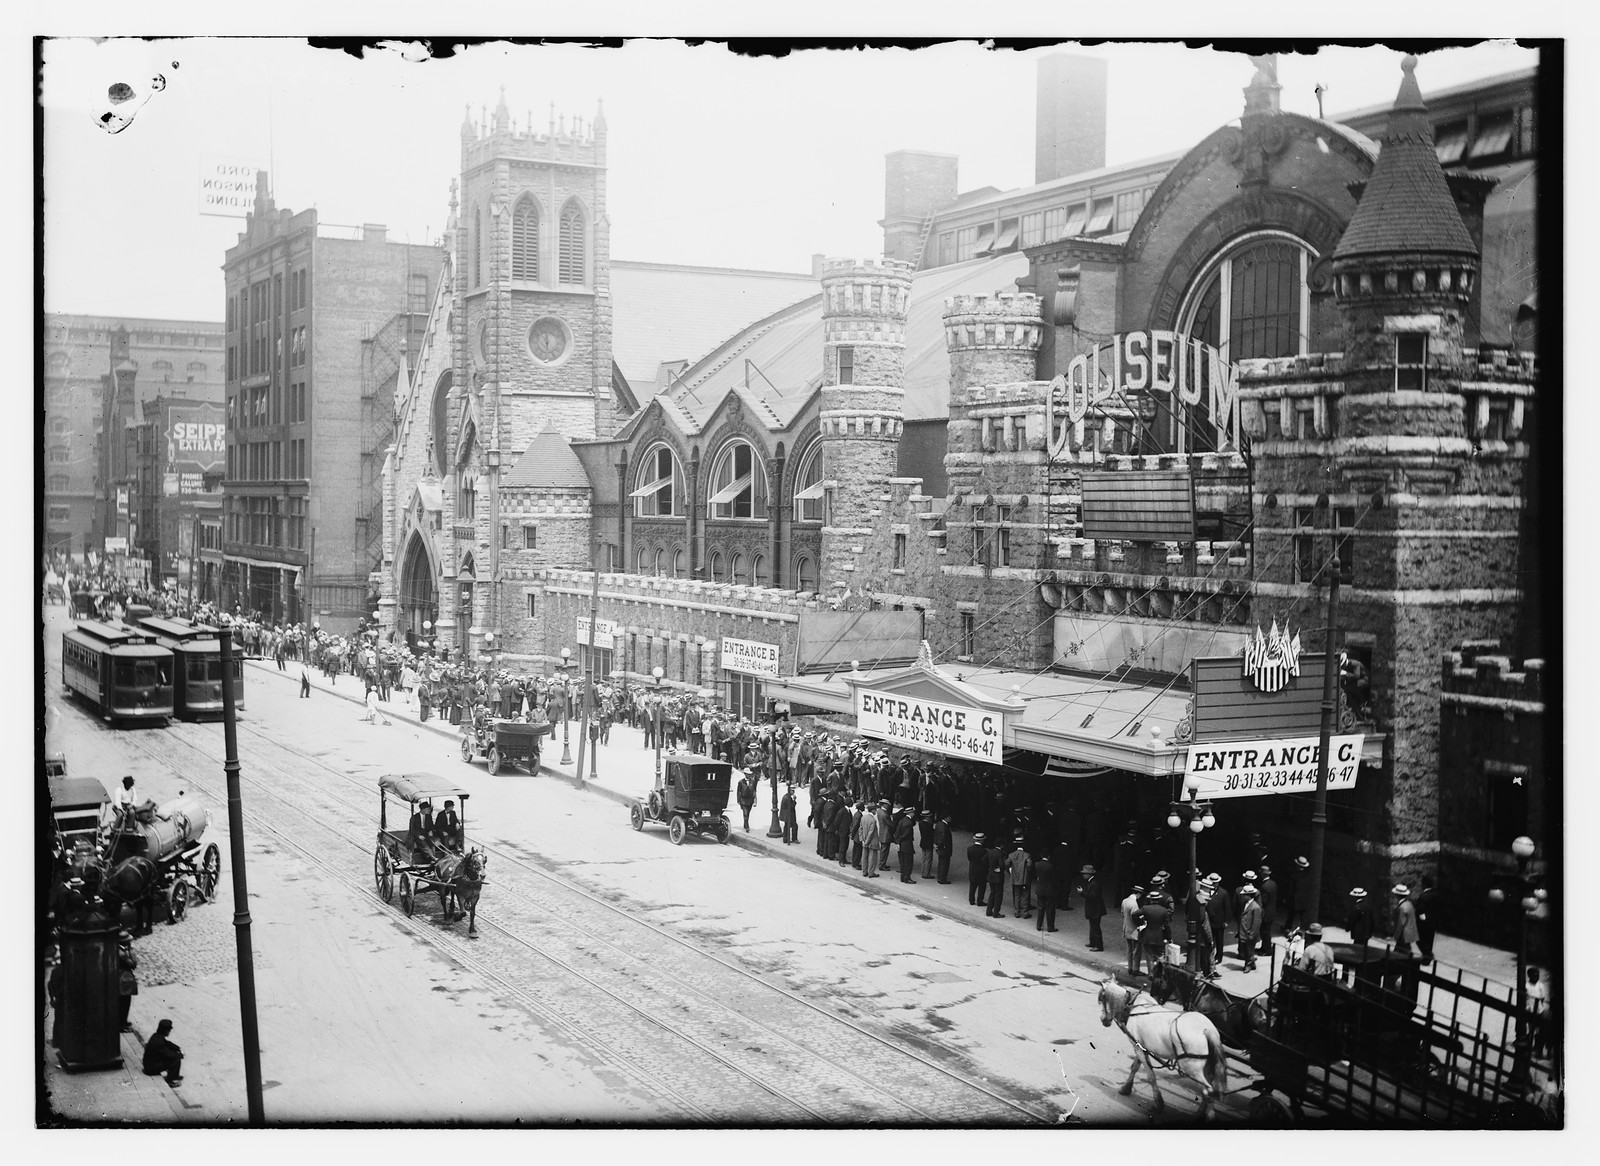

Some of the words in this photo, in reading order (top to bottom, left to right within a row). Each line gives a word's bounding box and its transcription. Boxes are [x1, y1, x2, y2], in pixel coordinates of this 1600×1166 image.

[1047, 329, 1240, 457] COLISEUM
[179, 439, 213, 453] EXTRA
[724, 641, 767, 660] ENTRANCE
[863, 694, 966, 731] ENTRANCE
[981, 716, 998, 737] C.
[1192, 745, 1321, 772] ENTRANCE
[1337, 743, 1356, 762] C.
